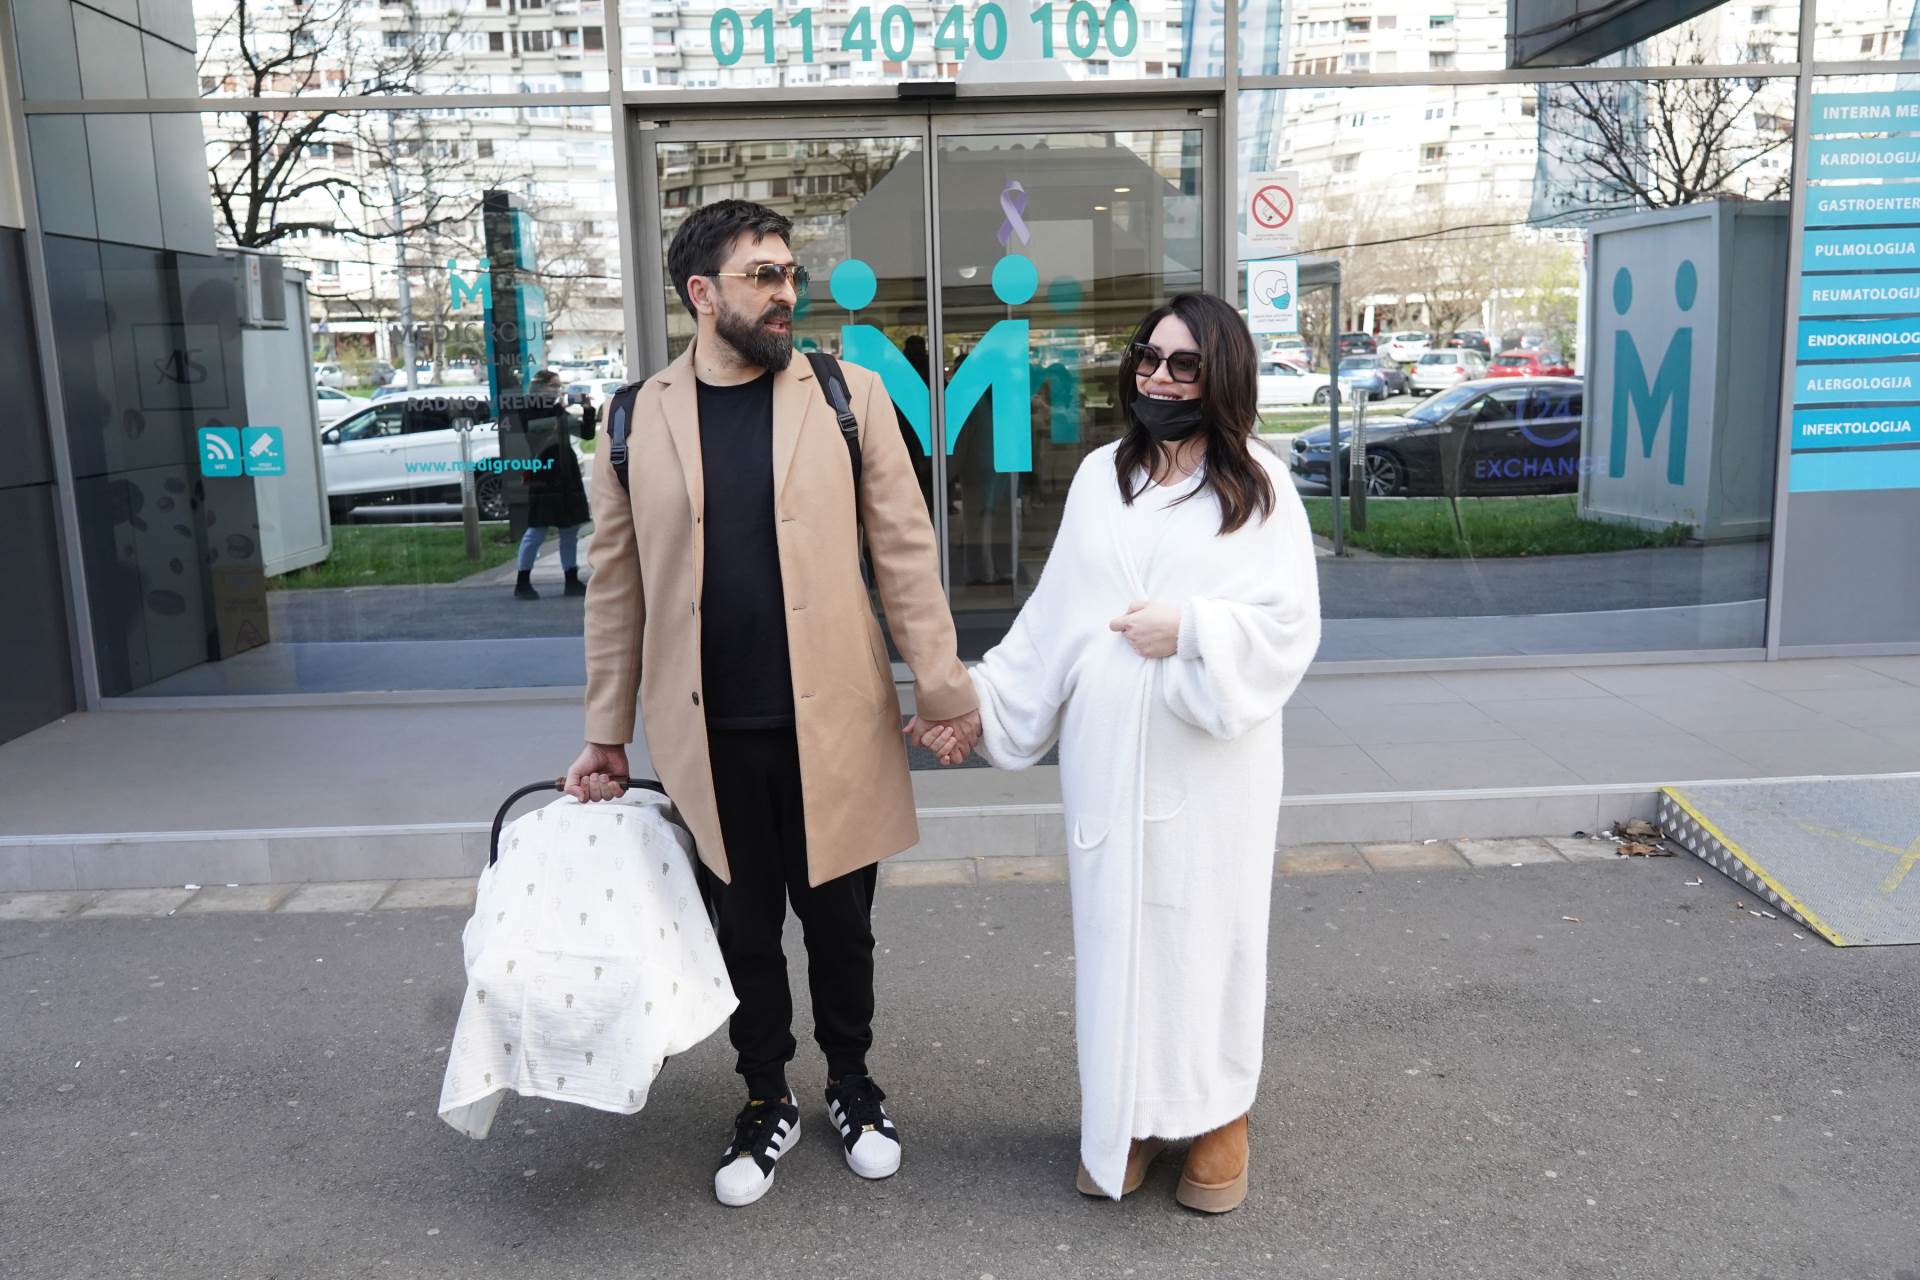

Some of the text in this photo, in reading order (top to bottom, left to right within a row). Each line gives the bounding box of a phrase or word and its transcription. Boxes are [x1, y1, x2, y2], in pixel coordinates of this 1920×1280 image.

[710, 0, 1139, 66] 011 40 40 100
[1823, 105, 1891, 120] INTERNA
[1818, 198, 1920, 212] GASTROENTER
[1815, 242, 1915, 257] PULMOLOGIJA
[1812, 287, 1920, 302] REUMATOLOGIJ
[1808, 332, 1920, 347] ENDOKRINOLOG
[1806, 376, 1912, 391] ALERGOLOGIJA
[407, 392, 555, 412] RADNO VREME
[1802, 420, 1912, 436] INFEKTOLOGIJA
[405, 457, 555, 475] www.medigroup.r
[1475, 456, 1609, 479] EXCHANGE
